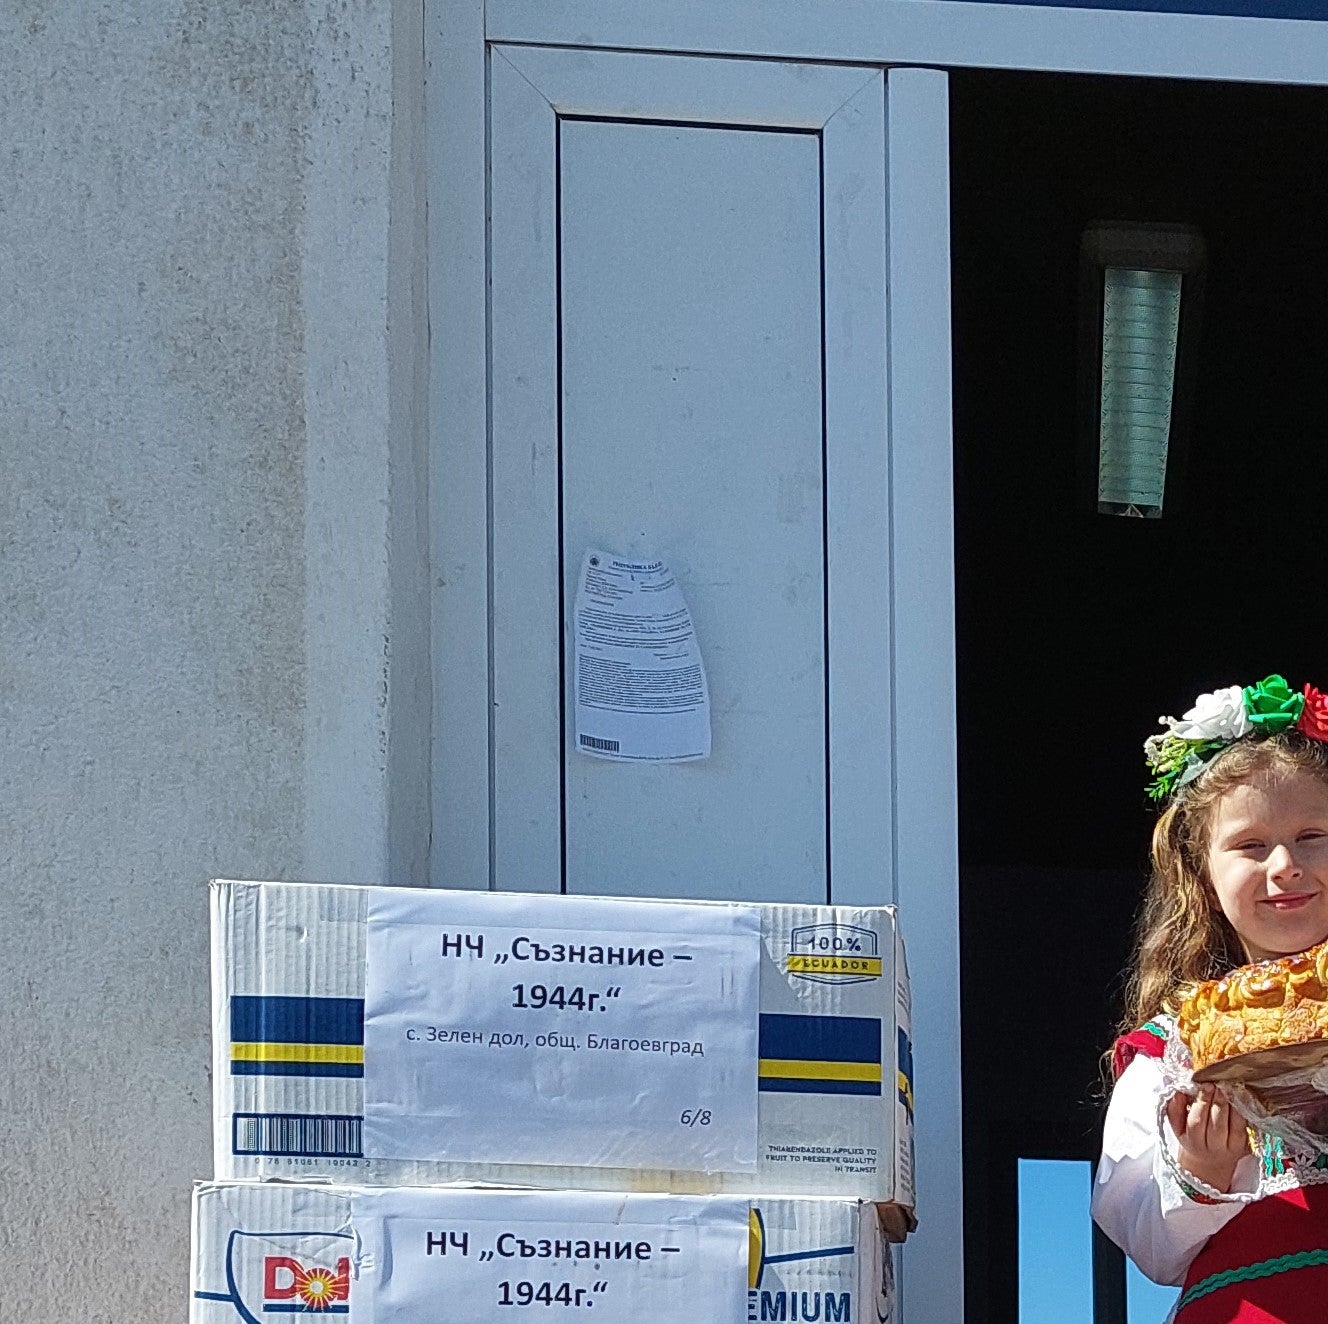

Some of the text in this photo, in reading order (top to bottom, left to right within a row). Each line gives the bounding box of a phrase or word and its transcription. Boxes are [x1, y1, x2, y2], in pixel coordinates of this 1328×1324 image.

[441, 933, 484, 959] НЧ
[808, 936, 862, 952] 100%
[803, 959, 869, 970] ECUADOR
[406, 1025, 705, 1058] с. Зелен дол, общ. Благоевград
[680, 1108, 712, 1128] 6/8
[866, 1148, 877, 1156] TO
[426, 1231, 469, 1257] НЧ
[264, 1256, 350, 1310] Dol
[748, 1290, 851, 1323] EMIUM
